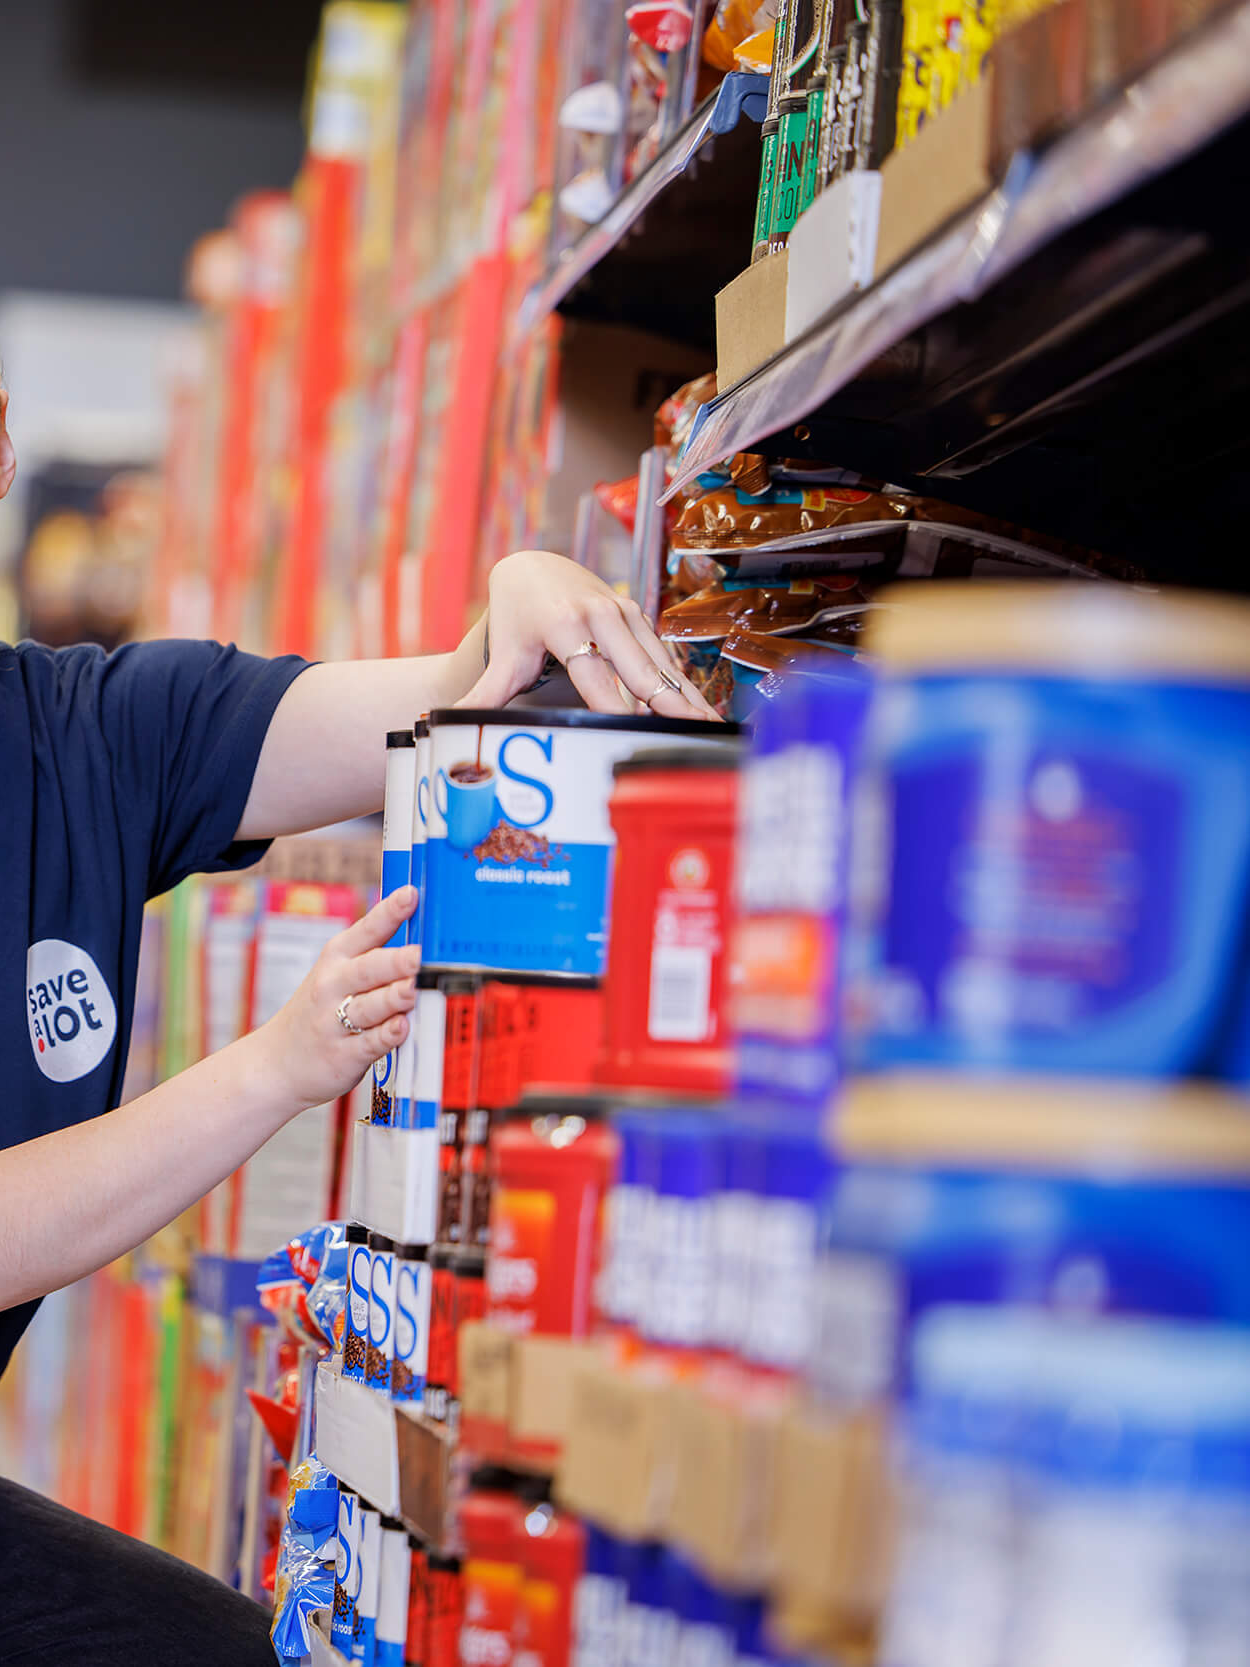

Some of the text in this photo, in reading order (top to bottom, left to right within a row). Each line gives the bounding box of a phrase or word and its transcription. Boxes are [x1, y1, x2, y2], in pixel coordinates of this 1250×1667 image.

[496, 733, 554, 828] S
[28, 969, 89, 1014] save
[42, 998, 103, 1048] lot
